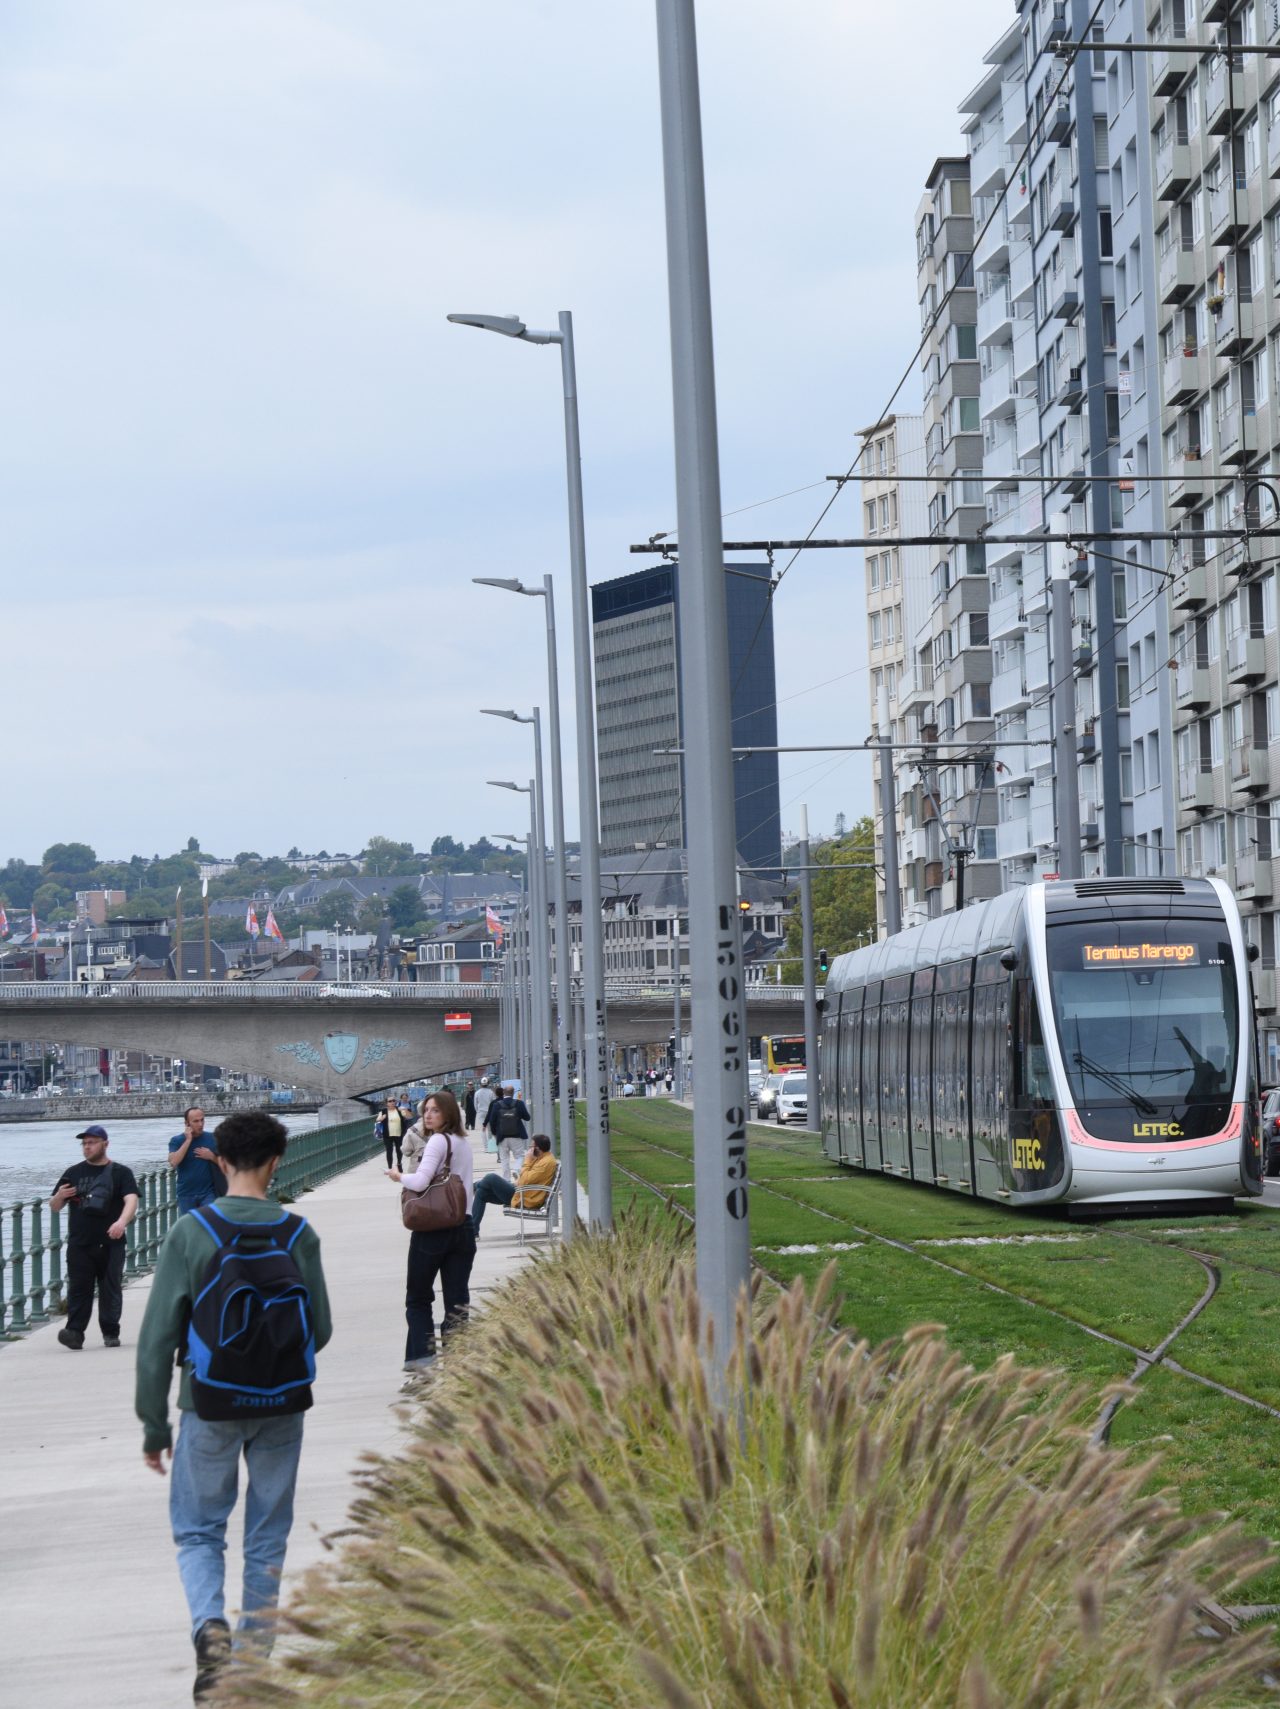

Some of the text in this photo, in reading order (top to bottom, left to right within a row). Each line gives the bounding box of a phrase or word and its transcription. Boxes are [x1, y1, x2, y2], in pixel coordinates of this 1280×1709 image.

[1084, 943, 1194, 960] Terminus Marengo
[1133, 1123, 1185, 1137] LETEC.
[1011, 1138, 1045, 1170] LETEC.
